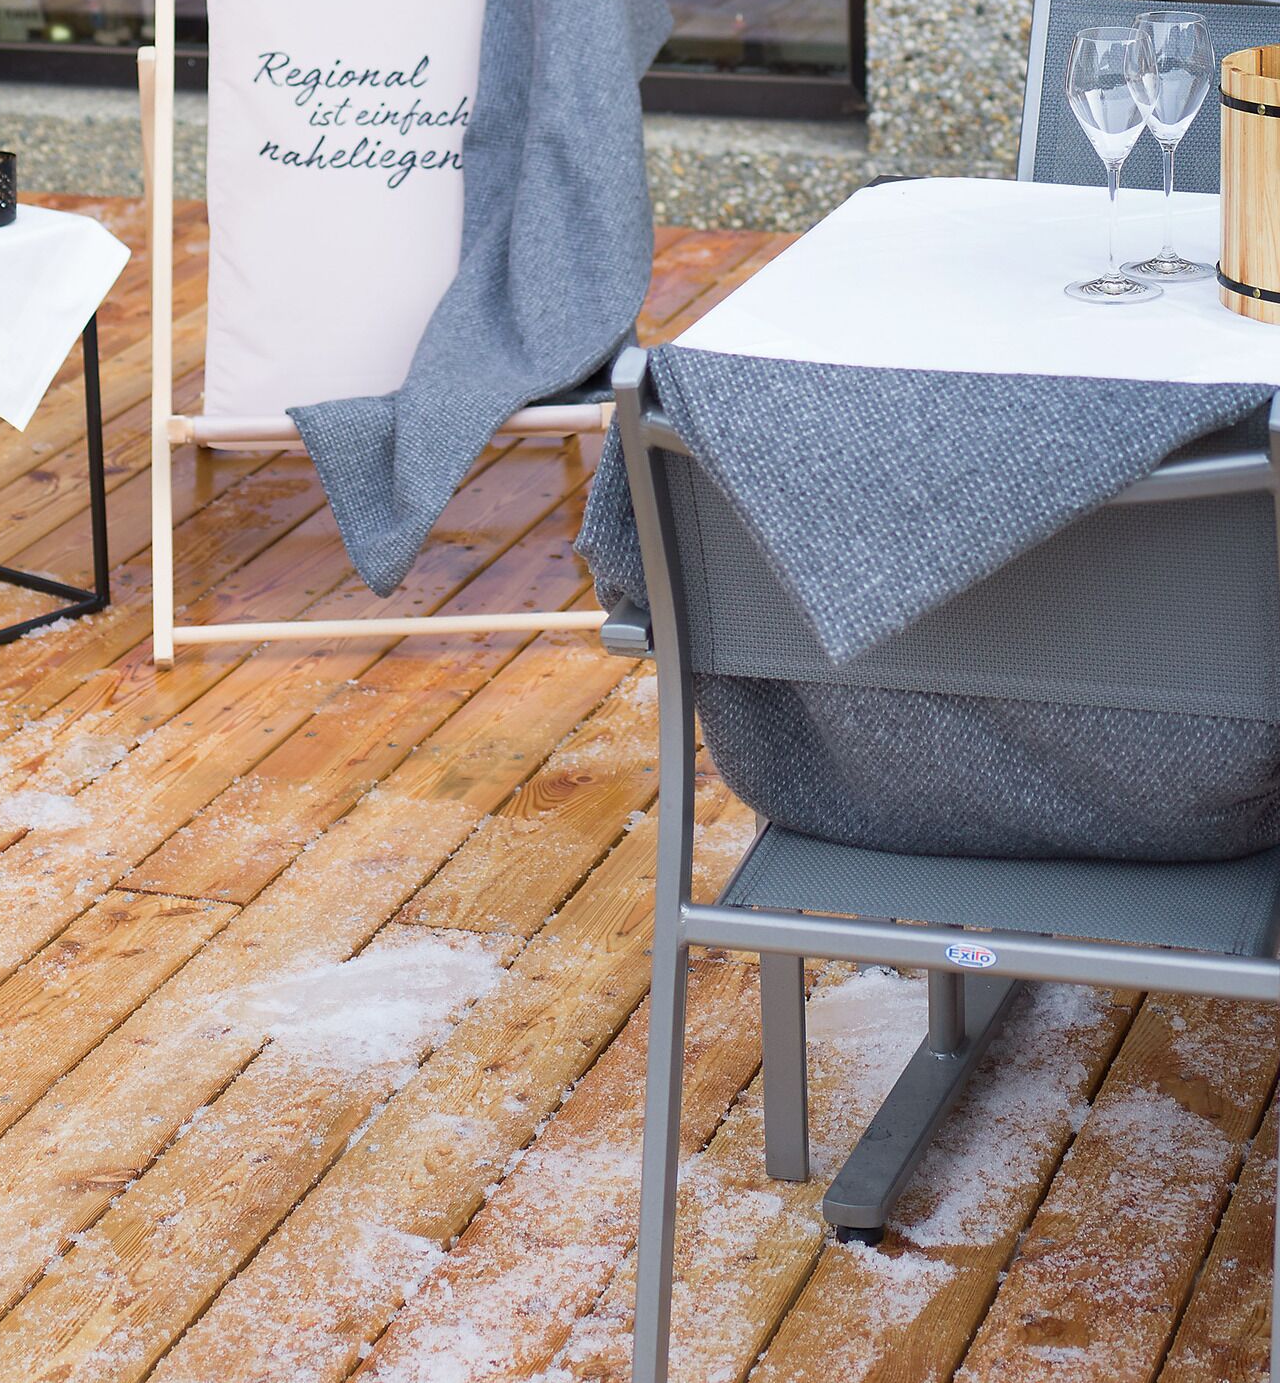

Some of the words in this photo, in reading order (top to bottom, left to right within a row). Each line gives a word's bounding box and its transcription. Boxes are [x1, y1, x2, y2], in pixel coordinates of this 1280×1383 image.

[253, 51, 429, 106] Regional
[309, 97, 352, 126] ist
[355, 96, 469, 135] einfach
[259, 135, 464, 189] naheliegen
